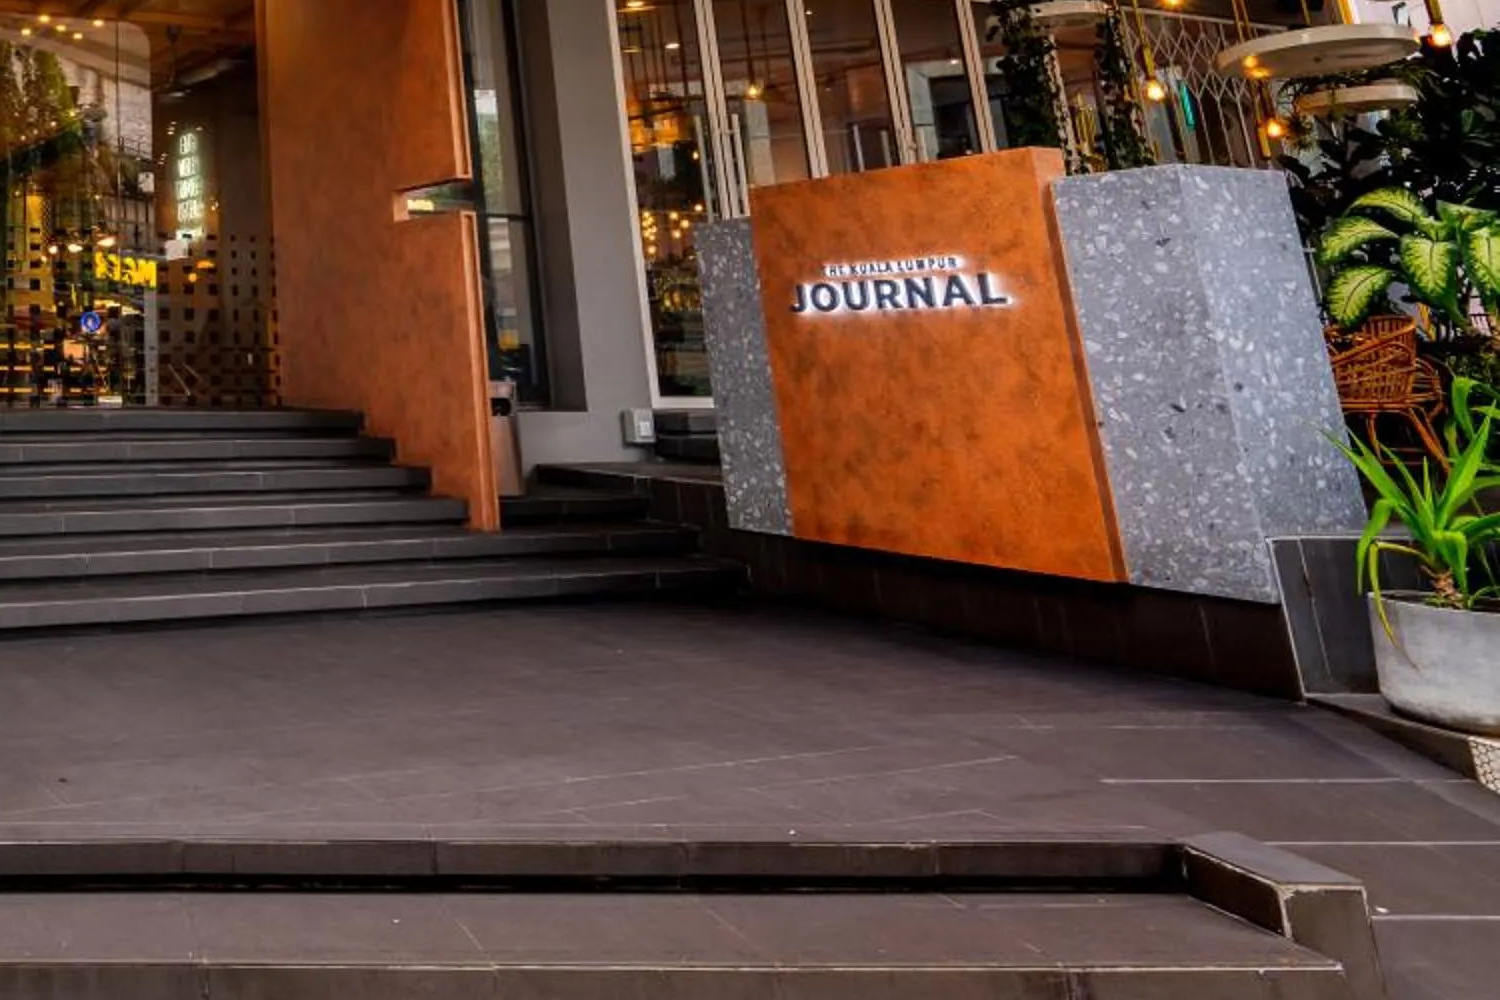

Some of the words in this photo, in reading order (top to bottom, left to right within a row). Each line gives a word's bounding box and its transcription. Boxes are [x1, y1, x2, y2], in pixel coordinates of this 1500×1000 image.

[850, 260, 893, 275] KUALA
[896, 257, 957, 271] LUMPUR
[789, 273, 1008, 314] JOURNAL
